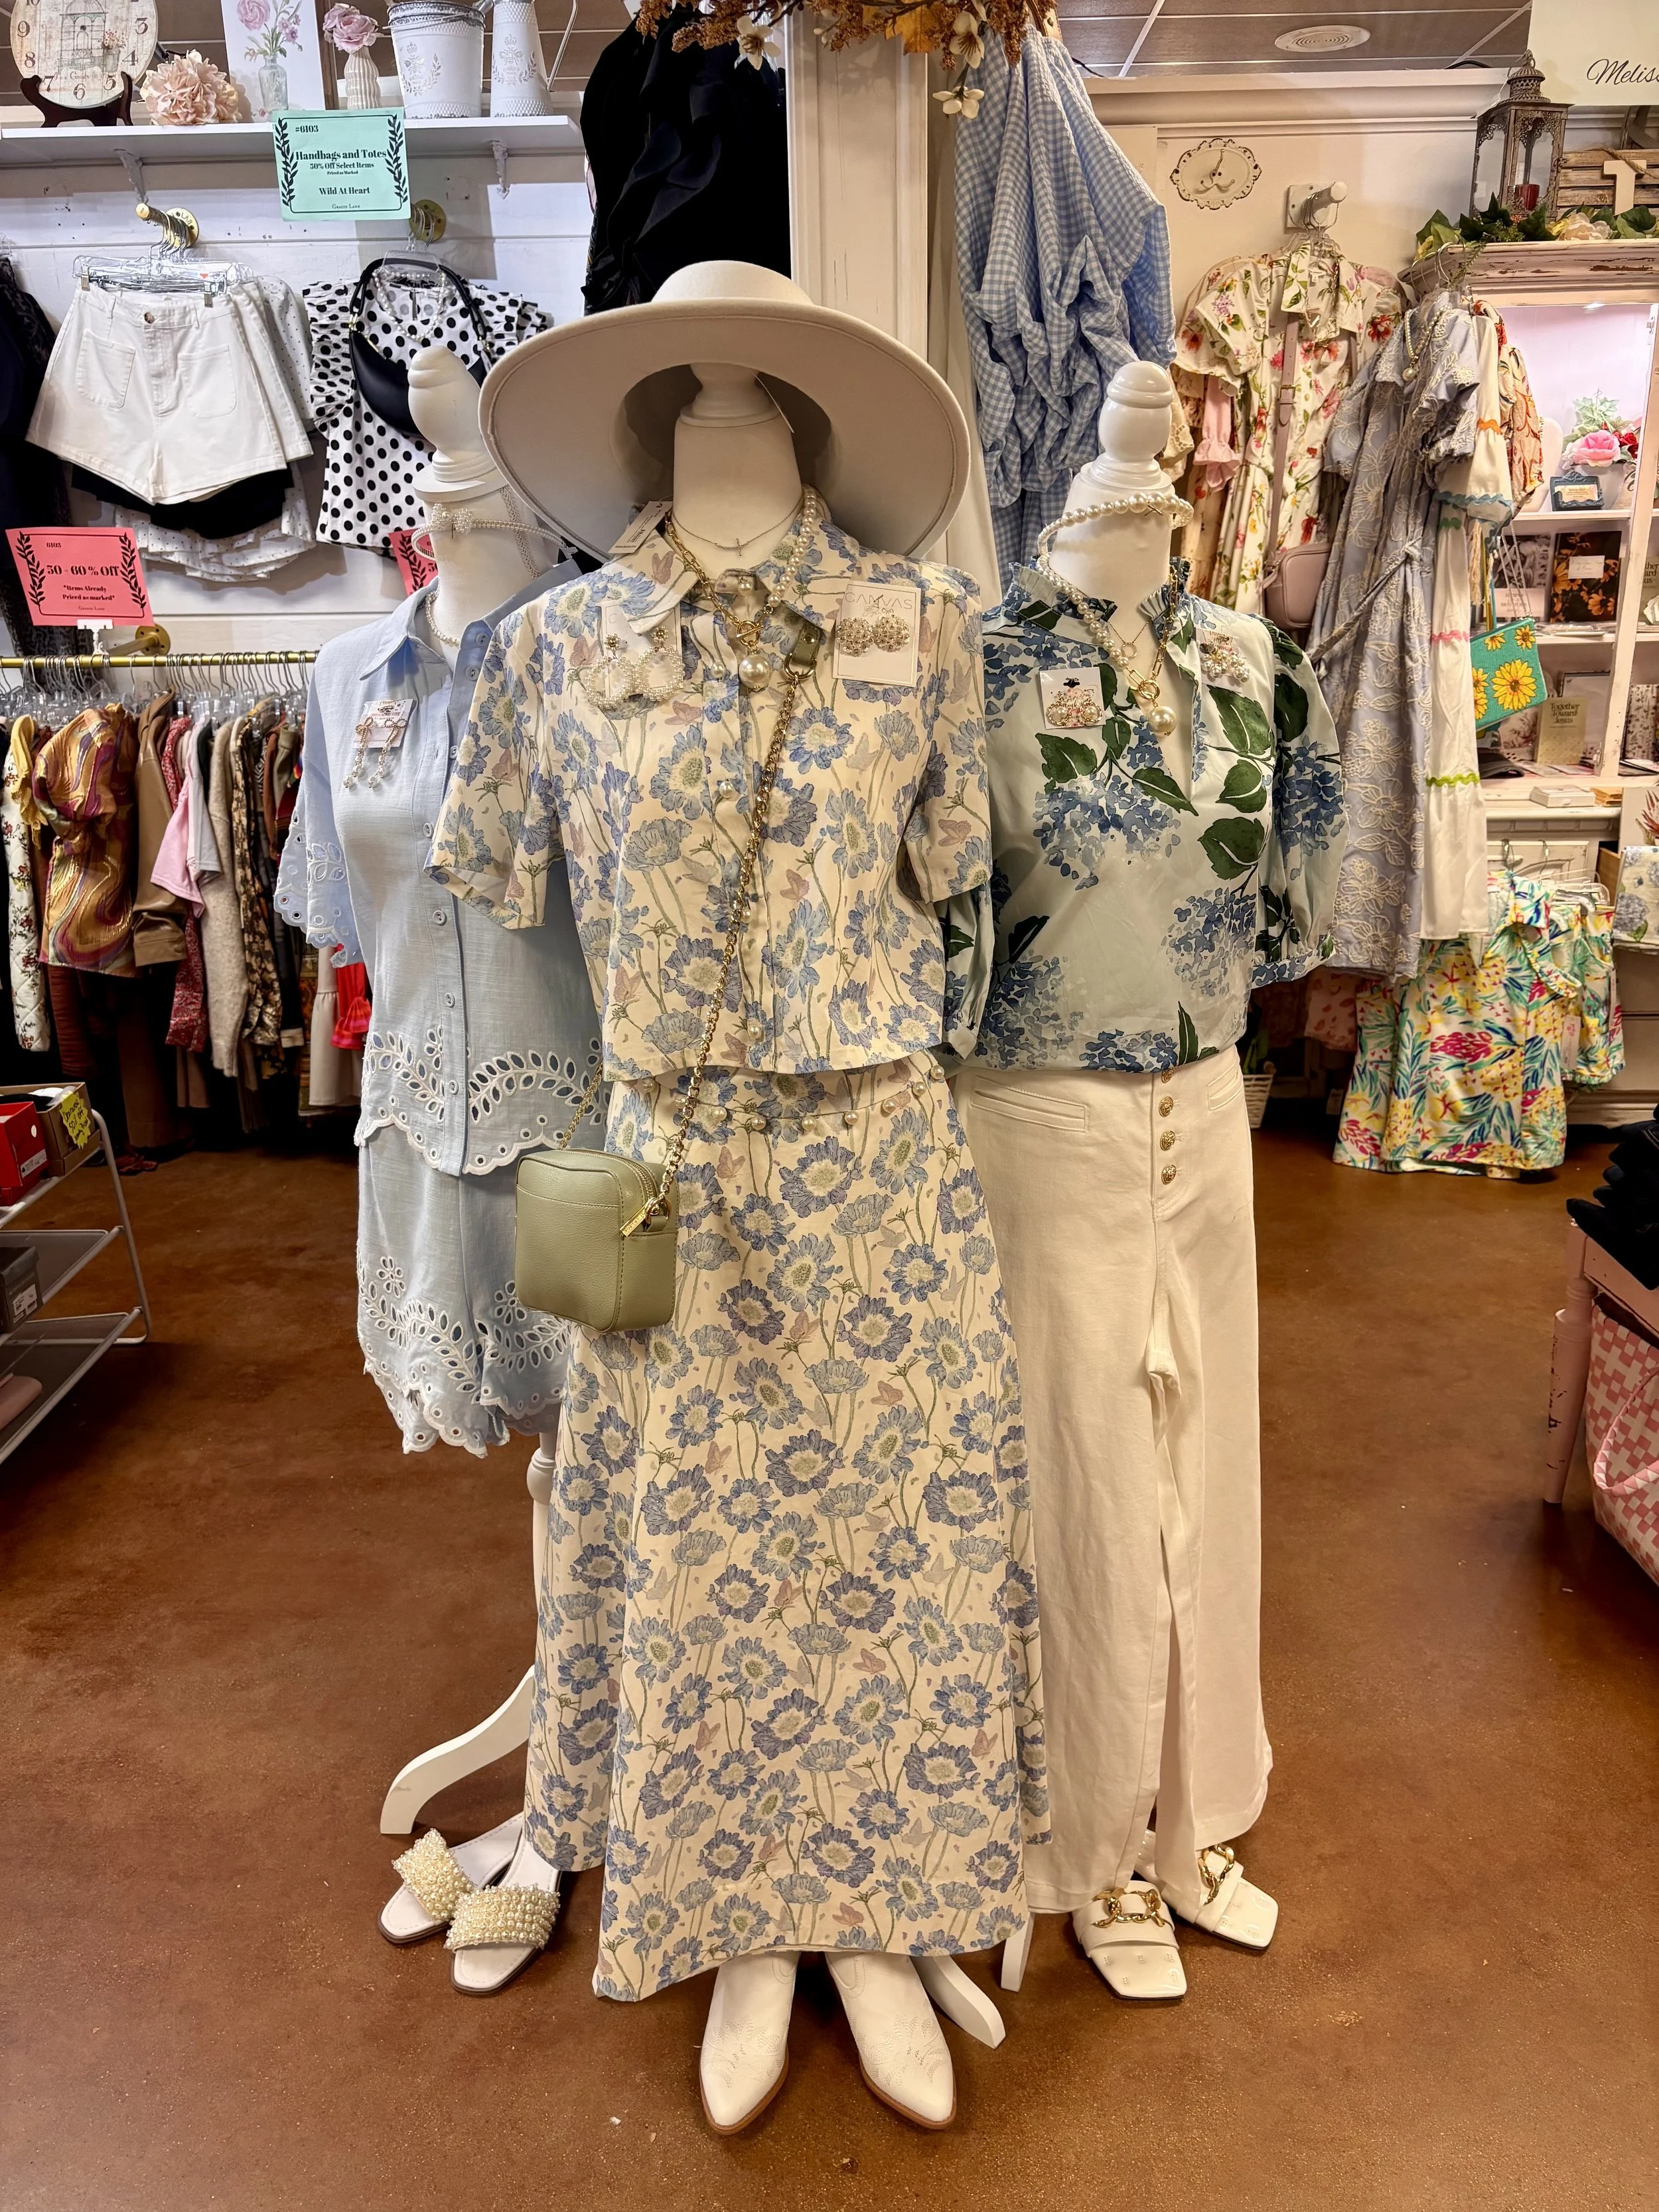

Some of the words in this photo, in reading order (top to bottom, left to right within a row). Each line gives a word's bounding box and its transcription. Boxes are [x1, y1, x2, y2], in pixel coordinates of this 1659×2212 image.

[17, 21, 31, 37] 9
[135, 17, 148, 35] 3
[25, 52, 36, 68] 8
[122, 50, 138, 66] 4
[42, 75, 55, 92] 7
[104, 74, 116, 90] 5
[73, 83, 86, 100] 6
[296, 150, 341, 161] Handbags
[342, 149, 360, 159] and
[361, 149, 387, 158] Totes
[46, 565, 62, 575] 50
[100, 565, 119, 576] Off
[845, 592, 912, 609] CANVAS
[1550, 702, 1580, 711] Together
